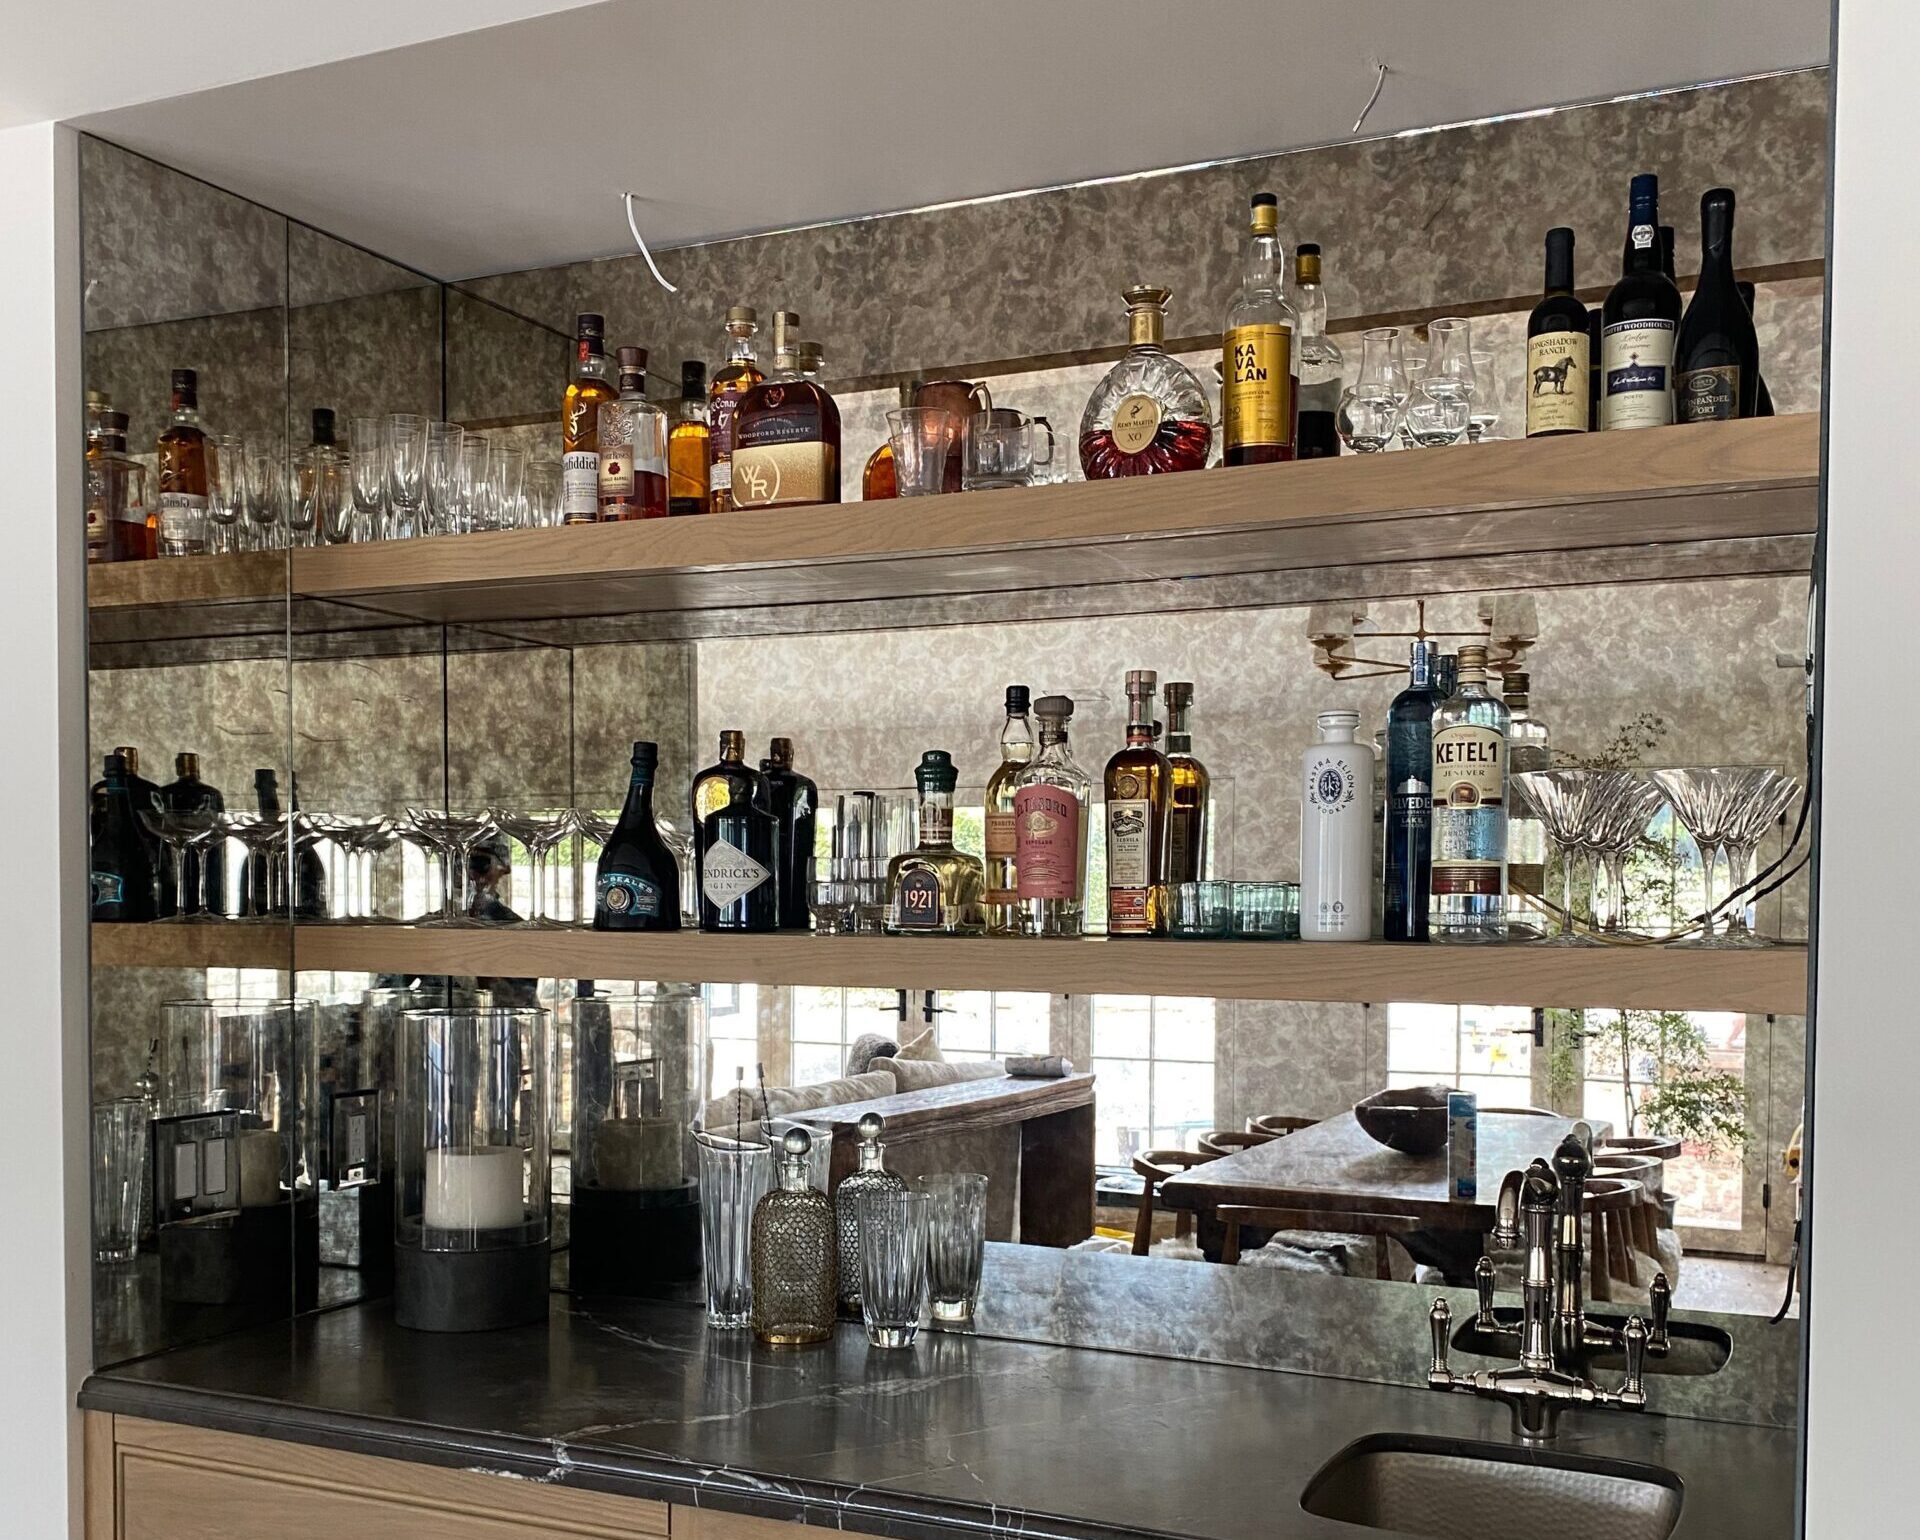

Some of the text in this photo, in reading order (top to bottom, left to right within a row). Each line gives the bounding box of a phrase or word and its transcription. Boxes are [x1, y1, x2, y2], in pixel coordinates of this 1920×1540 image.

[1624, 321, 1670, 331] WOODHOUSE
[1234, 343, 1256, 358] KA
[1539, 346, 1566, 357] RANCH
[1235, 356, 1256, 371] VA
[1234, 368, 1267, 384] LAN
[738, 430, 775, 440] WOODFORD
[776, 426, 809, 436] RESERVE
[1127, 432, 1142, 442] XO
[1309, 757, 1355, 790] KASTRA ELION
[1317, 804, 1347, 815] VODKA
[904, 889, 933, 908] 1921
